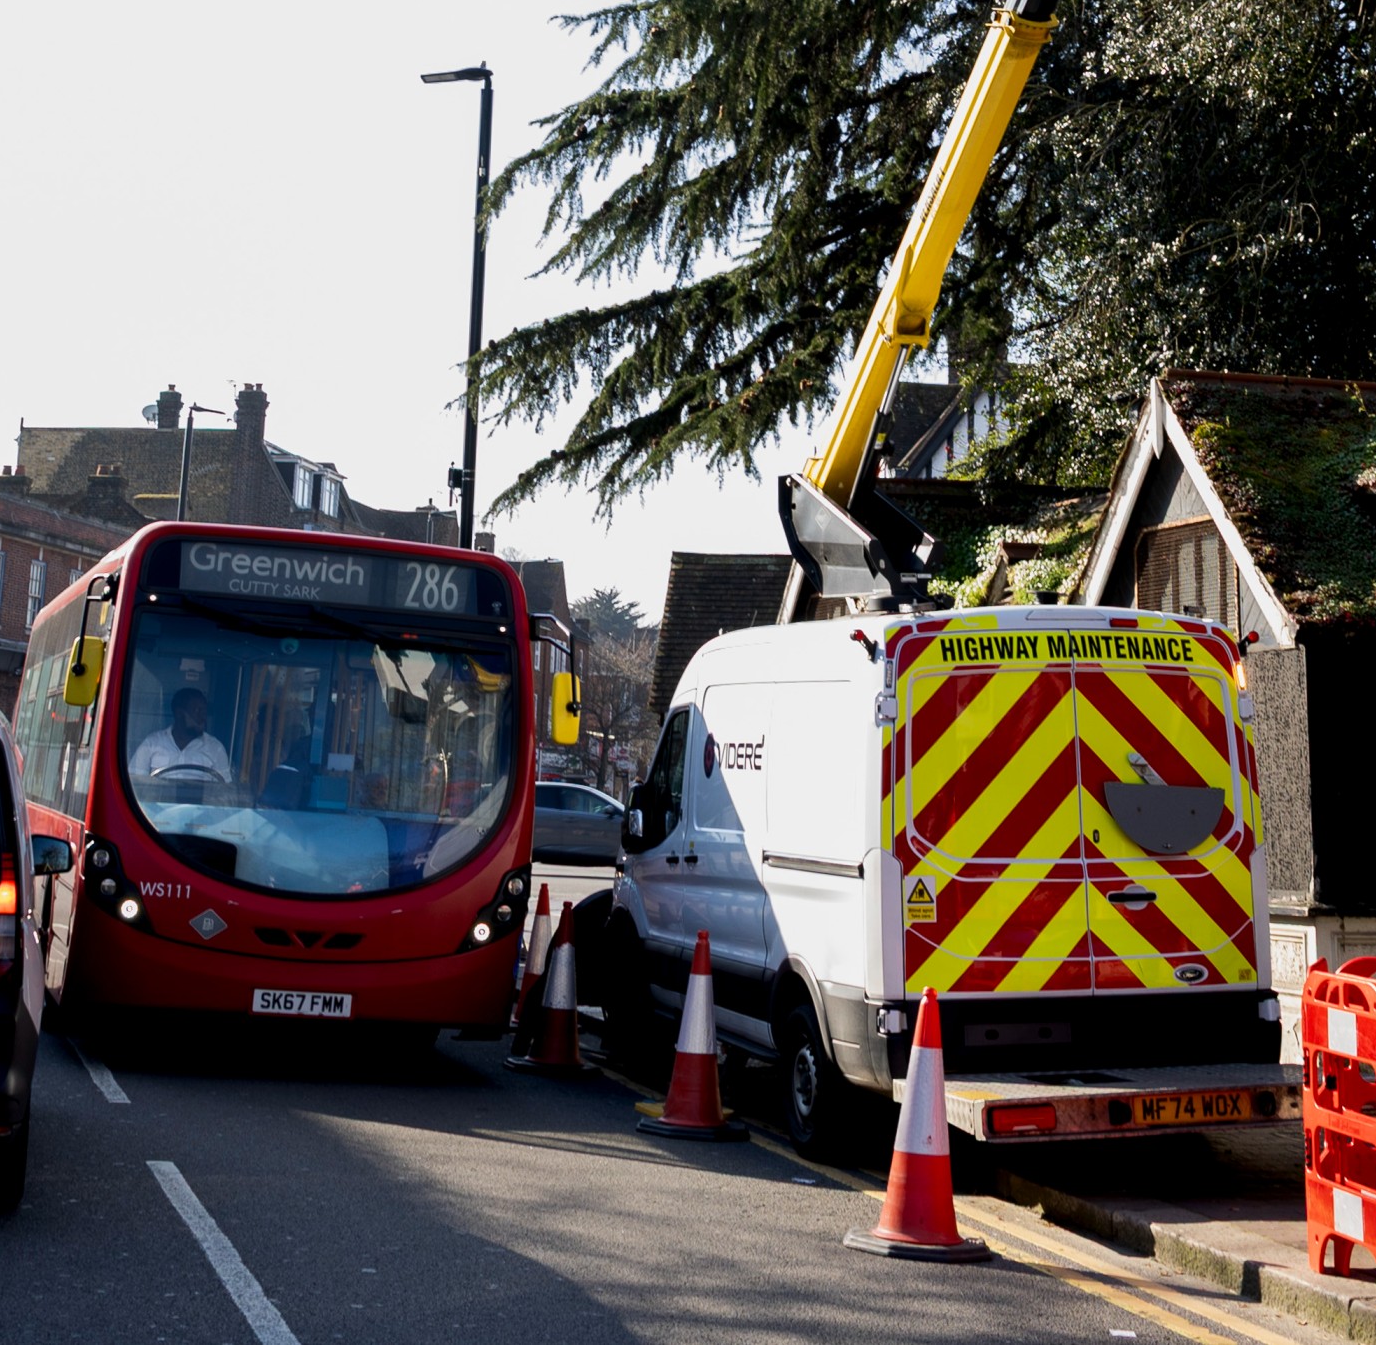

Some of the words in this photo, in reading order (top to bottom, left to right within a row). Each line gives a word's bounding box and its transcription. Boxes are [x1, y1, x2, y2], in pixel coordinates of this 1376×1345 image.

[189, 542, 364, 586] Greenwich
[229, 579, 279, 595] CUTTY
[284, 583, 321, 600] SARK
[405, 562, 459, 611] 286
[940, 635, 1039, 662] HIGHWAY
[1046, 635, 1194, 662] MAINTENANCE
[140, 881, 191, 899] WS111
[260, 992, 306, 1011] SK67
[310, 995, 344, 1013] FMM
[1142, 1097, 1196, 1120] MF74
[1202, 1094, 1243, 1117] WOX
